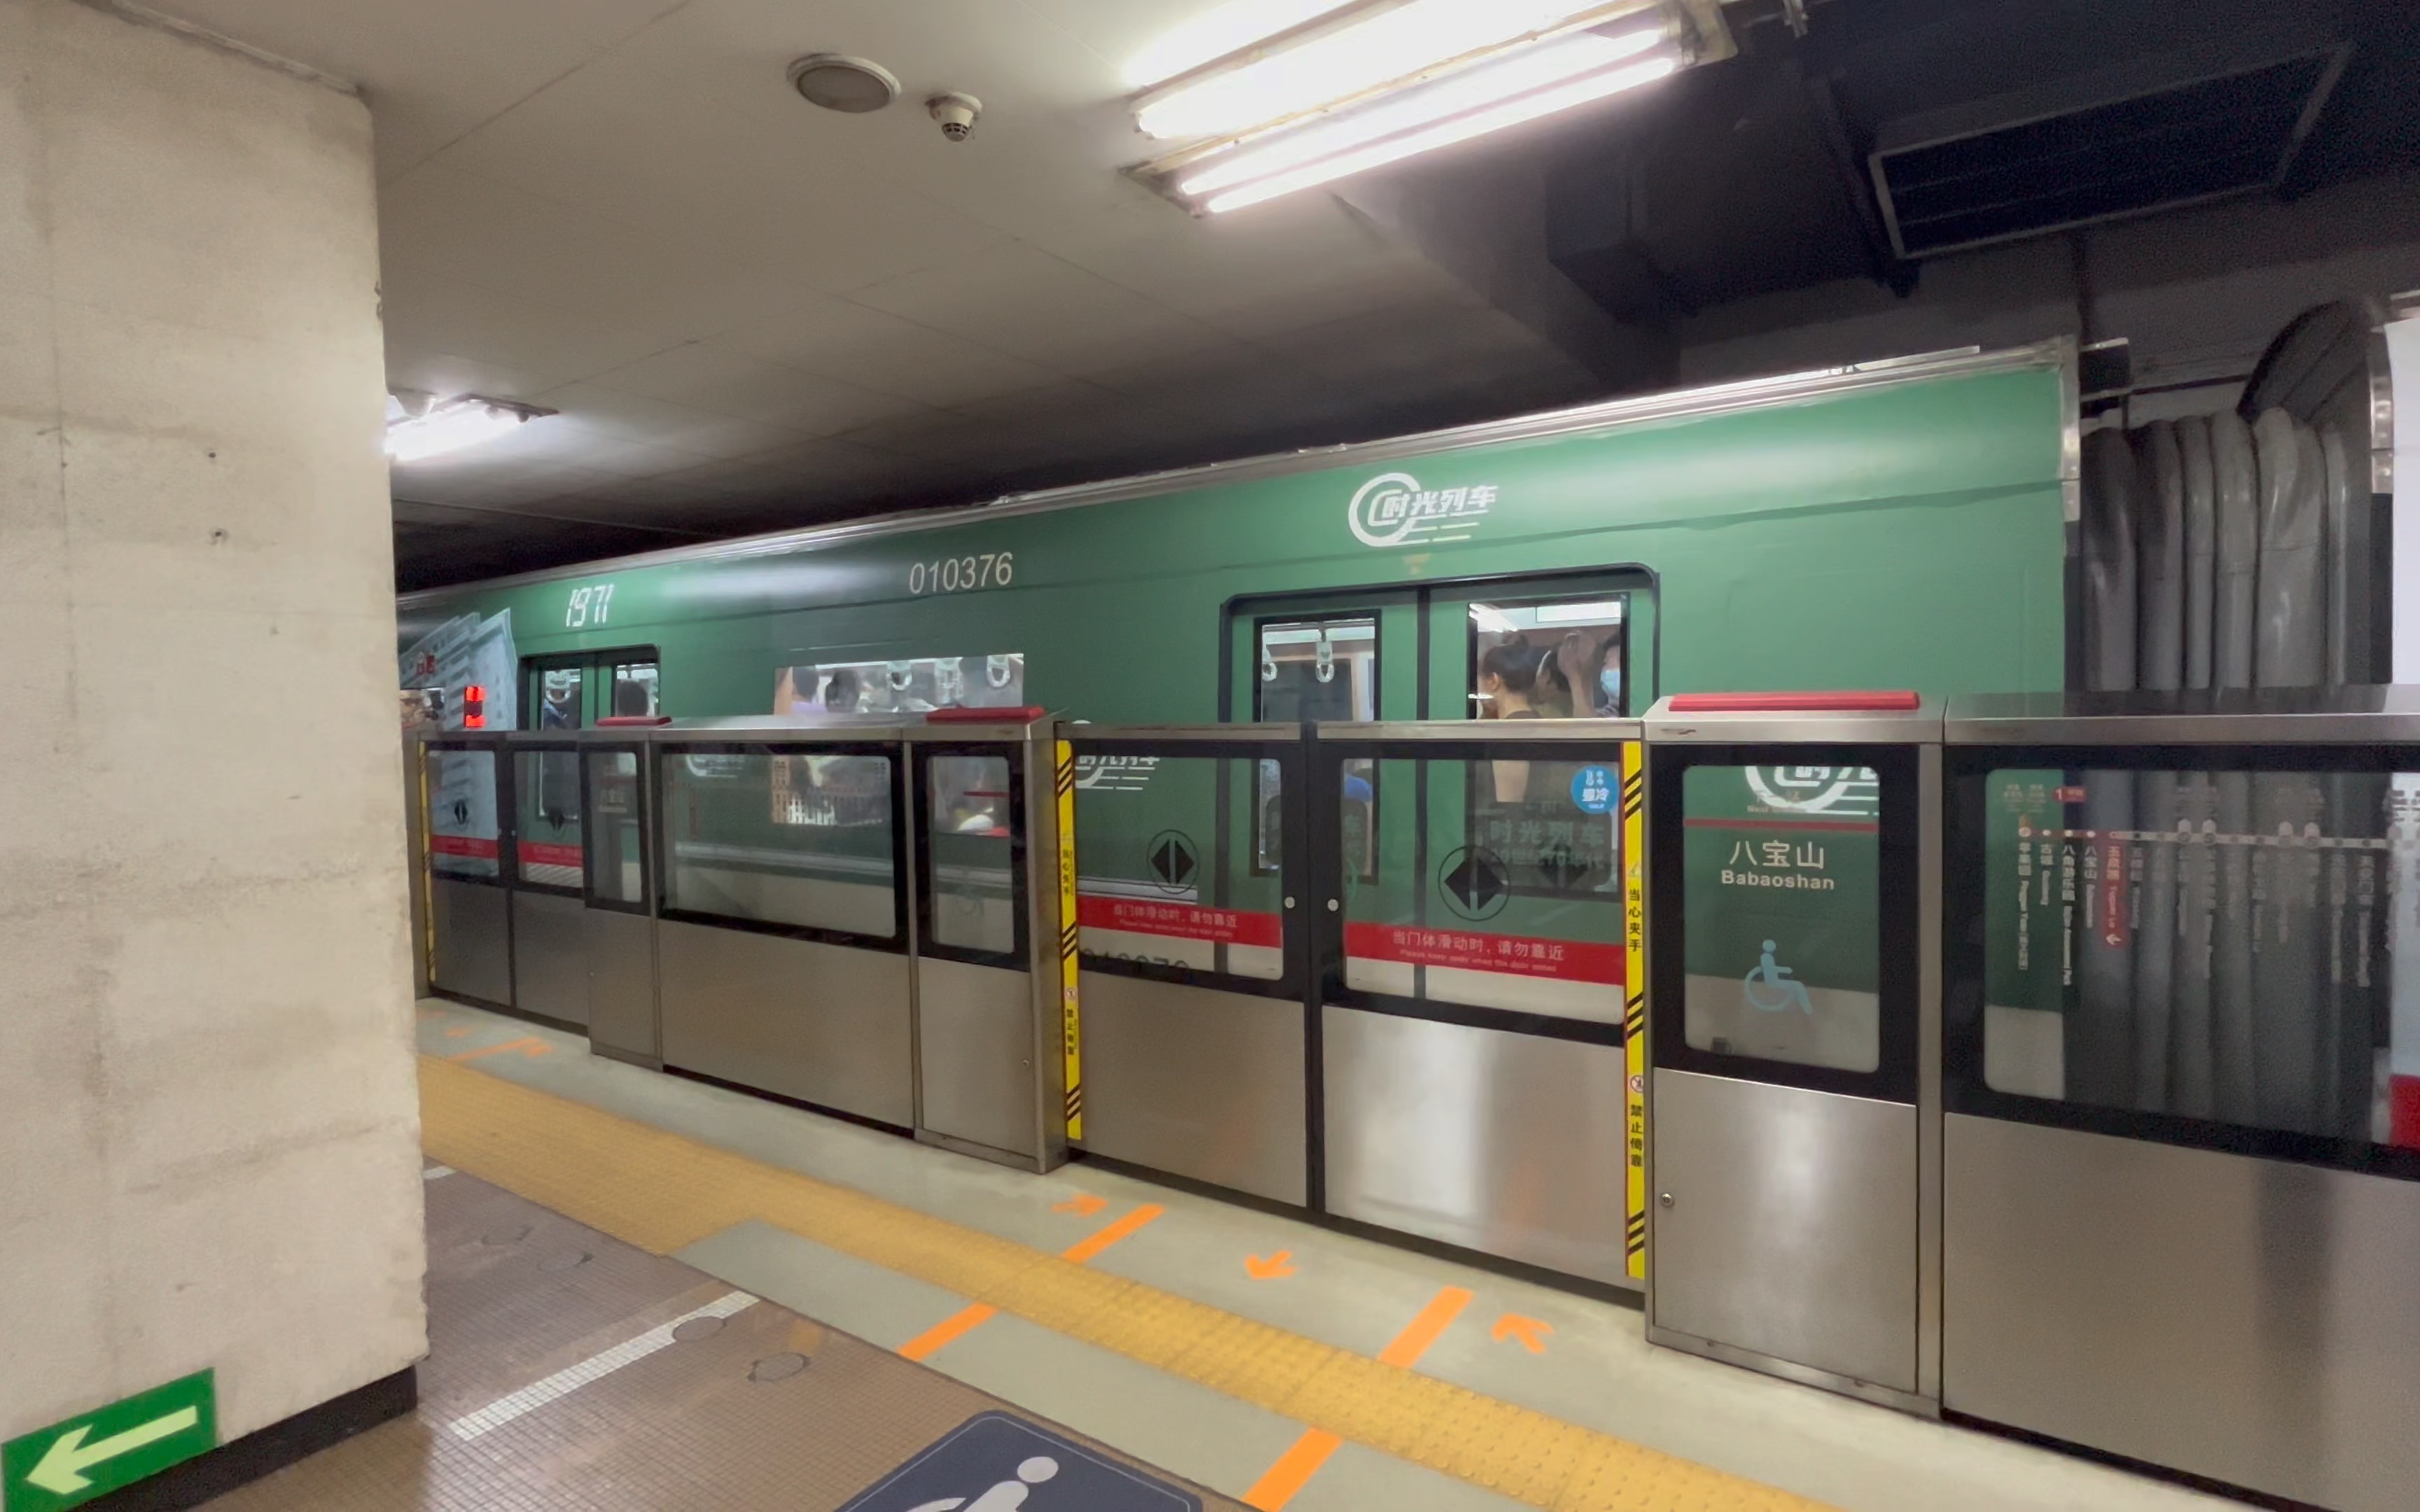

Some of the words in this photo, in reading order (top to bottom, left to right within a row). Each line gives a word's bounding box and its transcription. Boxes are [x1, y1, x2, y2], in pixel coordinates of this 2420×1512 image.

[1382, 486, 1498, 519] 时光列车
[910, 552, 1013, 594] 010376
[566, 584, 616, 627] 1971
[1729, 840, 1824, 869] 八宝山
[1721, 870, 1835, 890] Babaoshan
[1629, 888, 1641, 952] 当心夹手
